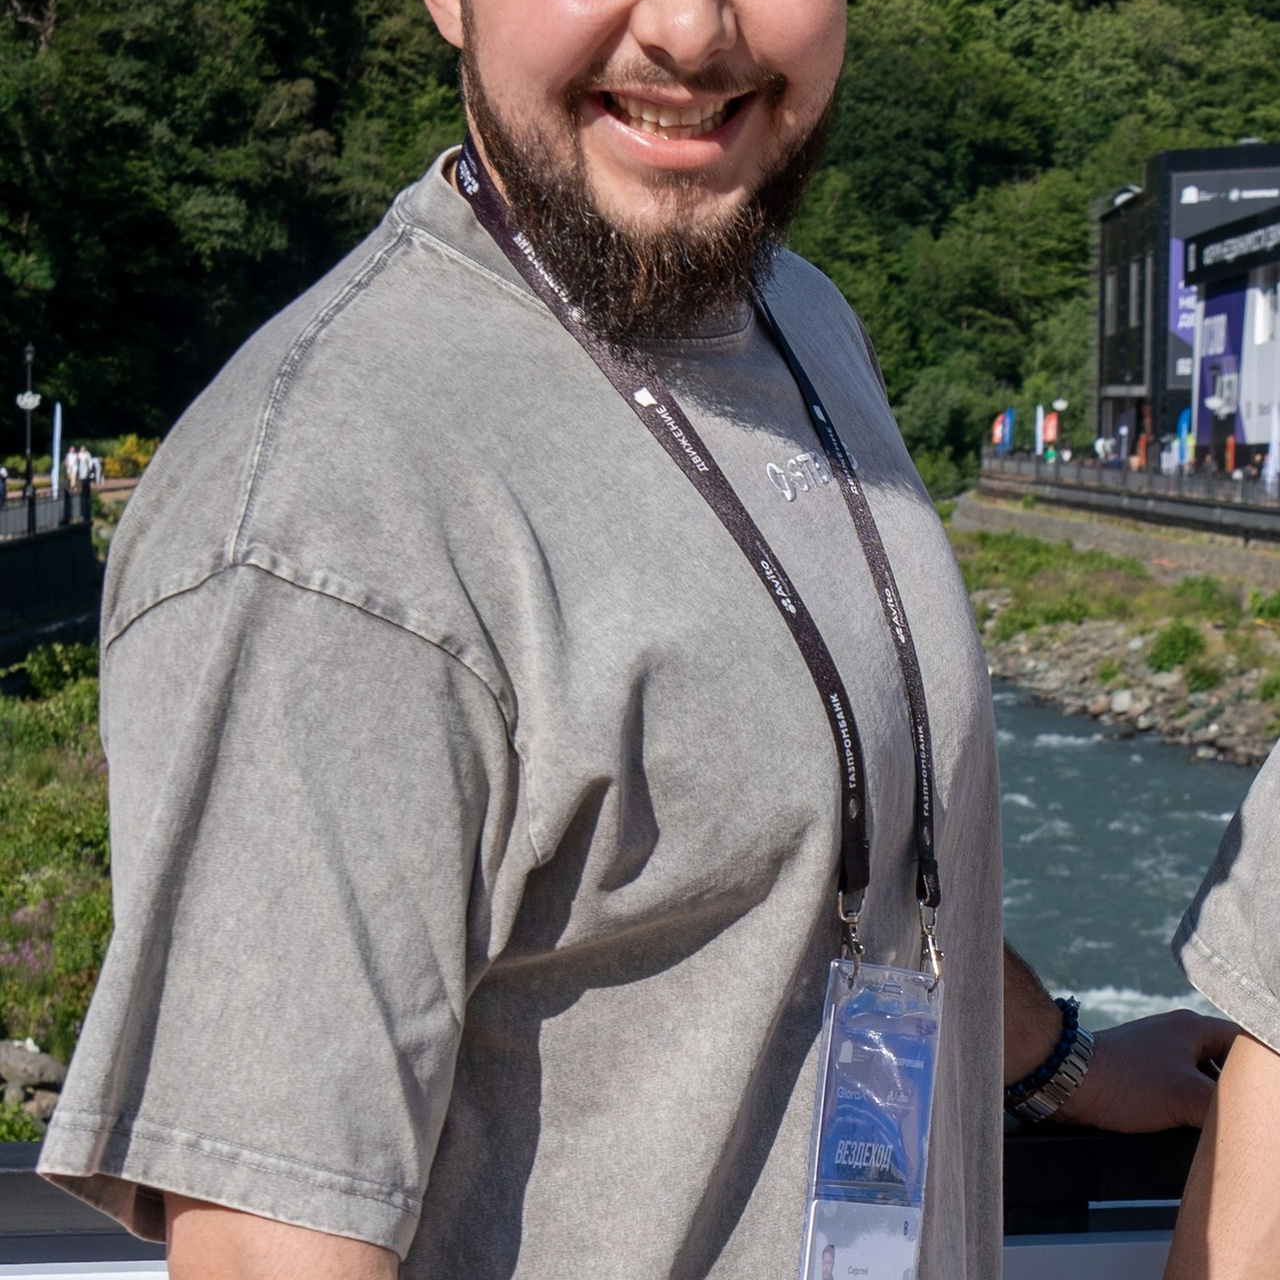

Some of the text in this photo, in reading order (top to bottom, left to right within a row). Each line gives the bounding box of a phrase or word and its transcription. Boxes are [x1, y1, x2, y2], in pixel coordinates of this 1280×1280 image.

[655, 405, 709, 472] ДВИЖЕНИЕ
[760, 559, 786, 596] Avito
[885, 587, 902, 627] Avito
[830, 692, 858, 788] ГАЗПРОМБАНК
[918, 724, 930, 817] ГАЗПРОМБАНК
[835, 1140, 894, 1171] ВЕЗДЕХОД
